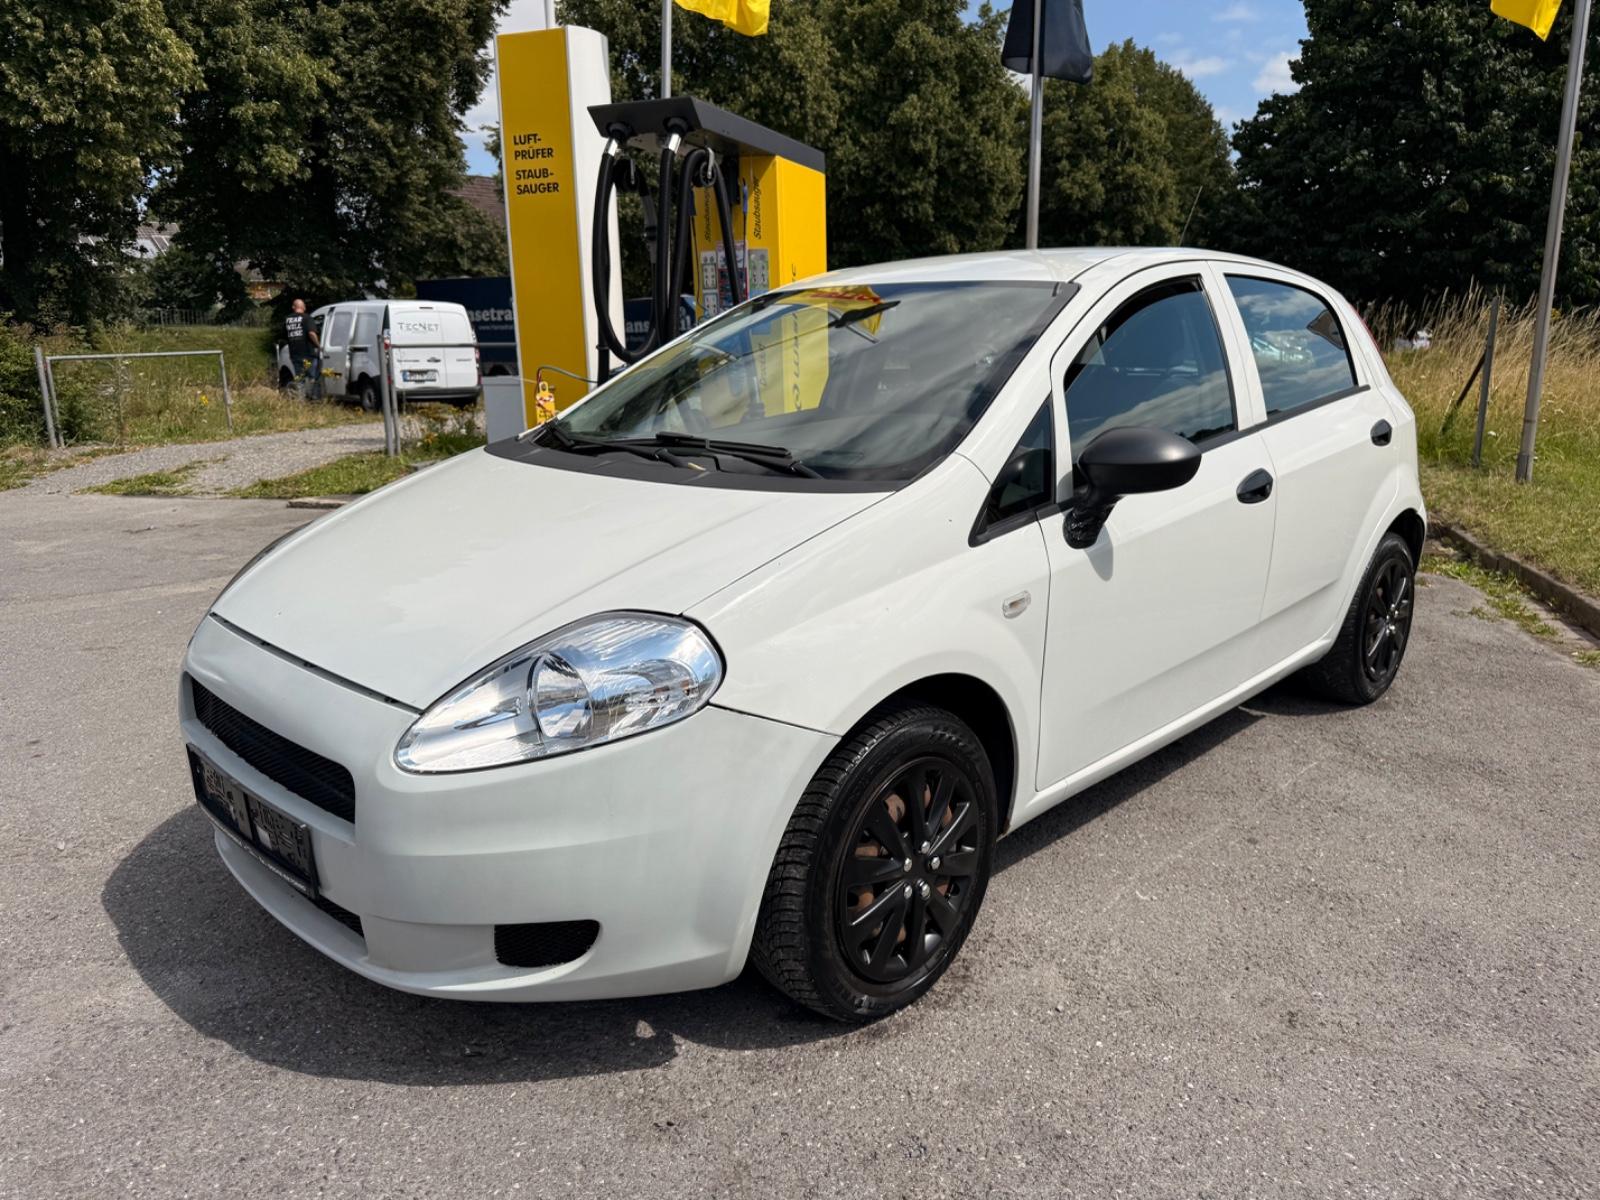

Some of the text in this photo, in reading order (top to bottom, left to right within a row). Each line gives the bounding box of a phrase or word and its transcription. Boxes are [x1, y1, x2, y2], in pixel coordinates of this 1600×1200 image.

[513, 133, 541, 146] LUFT-
[514, 146, 554, 160] PRÜFER
[515, 167, 554, 180] STAUB-
[516, 182, 559, 195] SAUGER
[753, 176, 761, 240] Staubsauger
[468, 307, 514, 322] nsetra
[625, 320, 650, 333] ans
